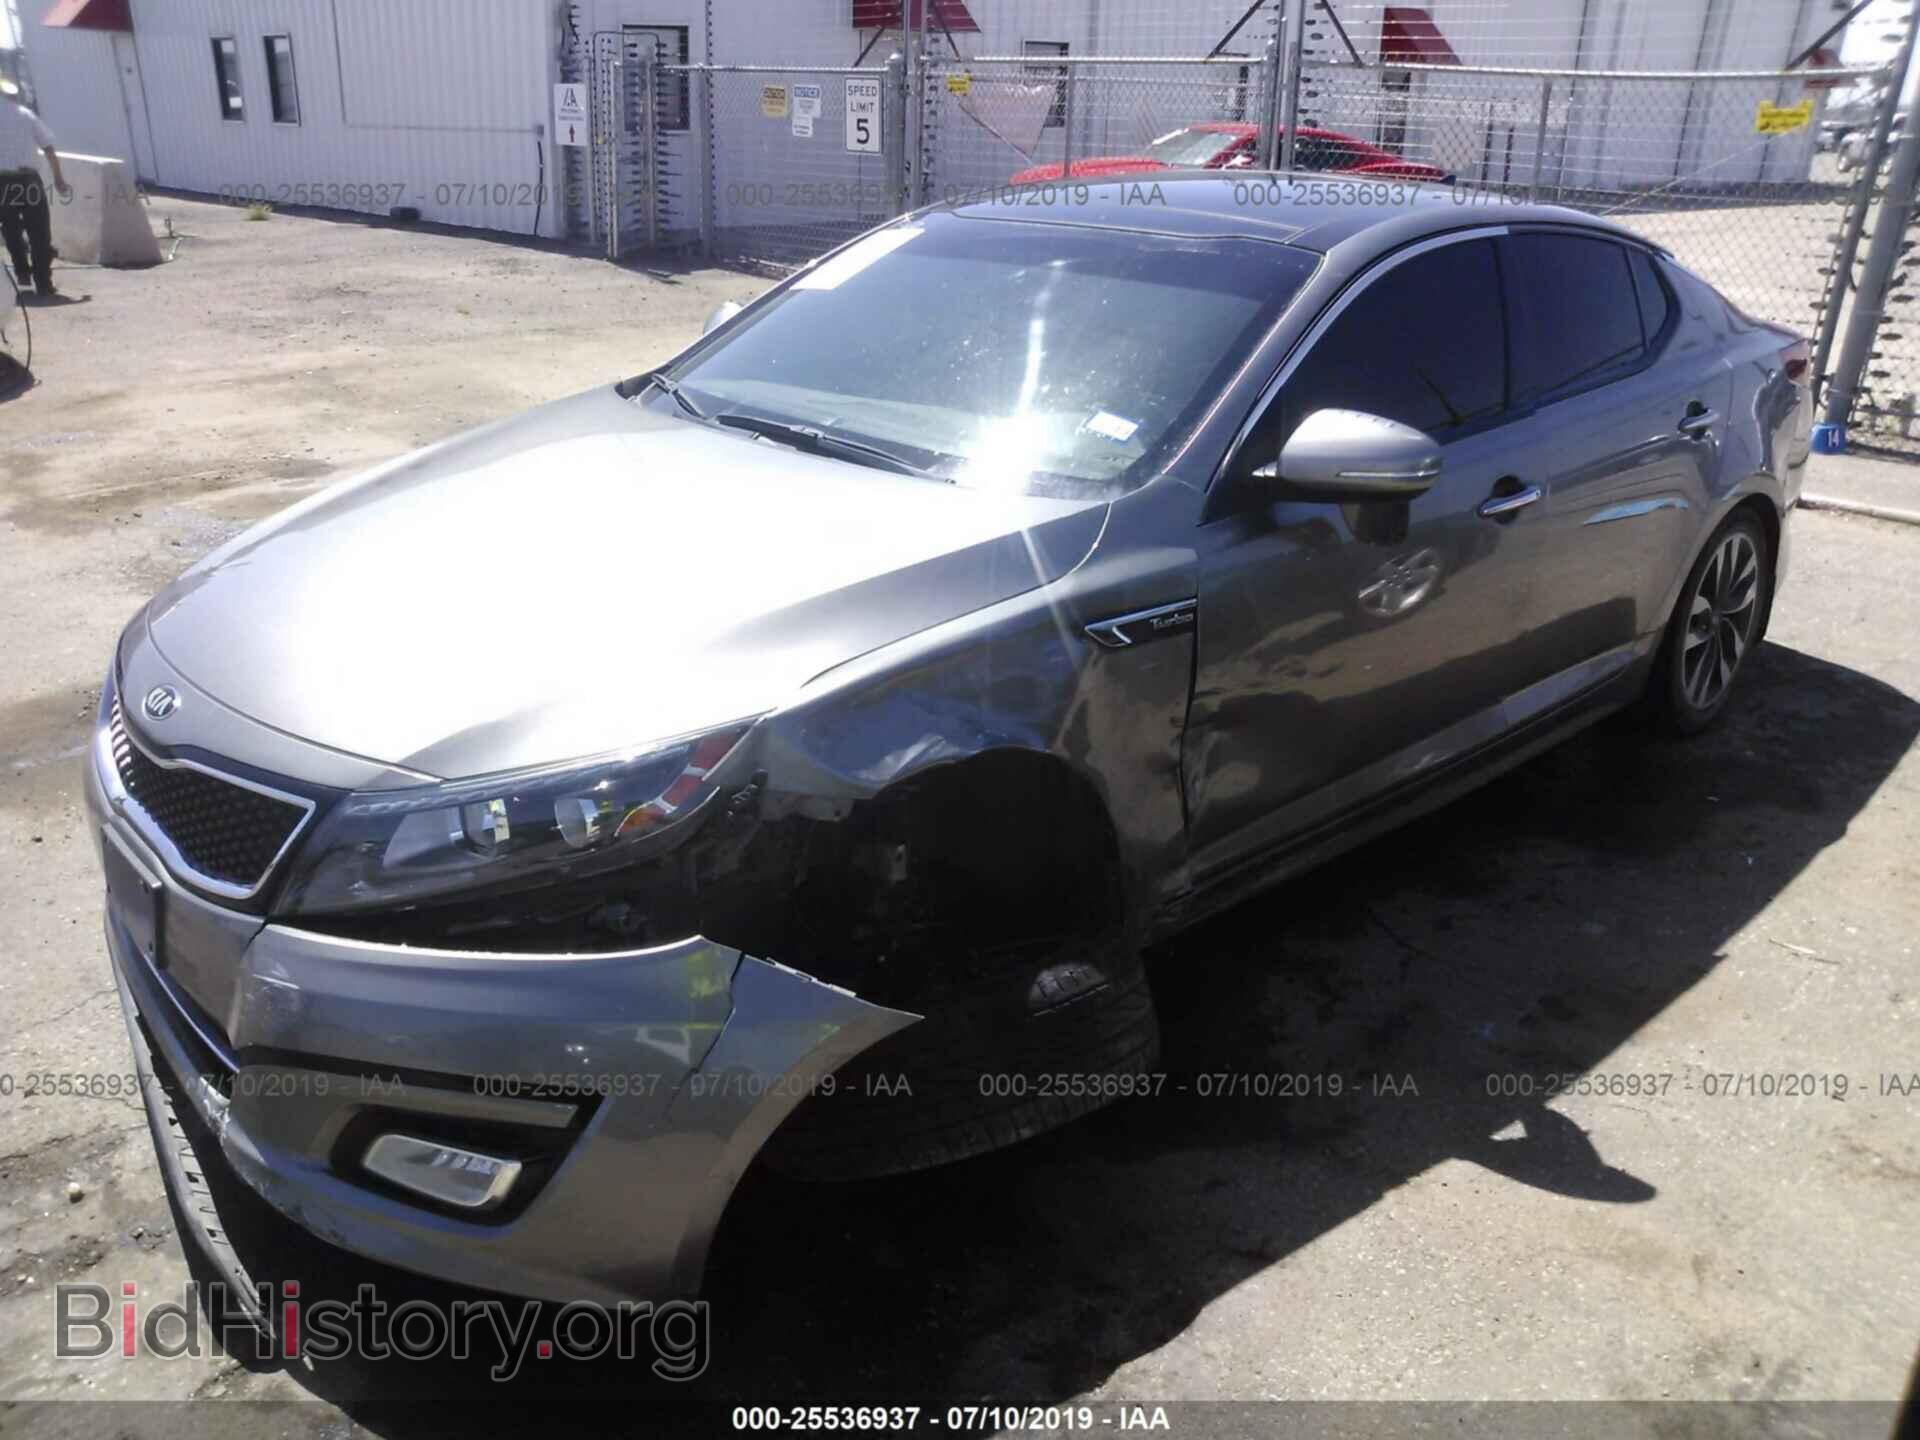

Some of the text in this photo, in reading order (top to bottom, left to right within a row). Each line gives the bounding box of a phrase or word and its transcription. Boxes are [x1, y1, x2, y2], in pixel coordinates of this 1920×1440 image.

[848, 85, 878, 97] SPEED
[850, 101, 874, 113] LIMIT
[857, 118, 870, 145] 5
